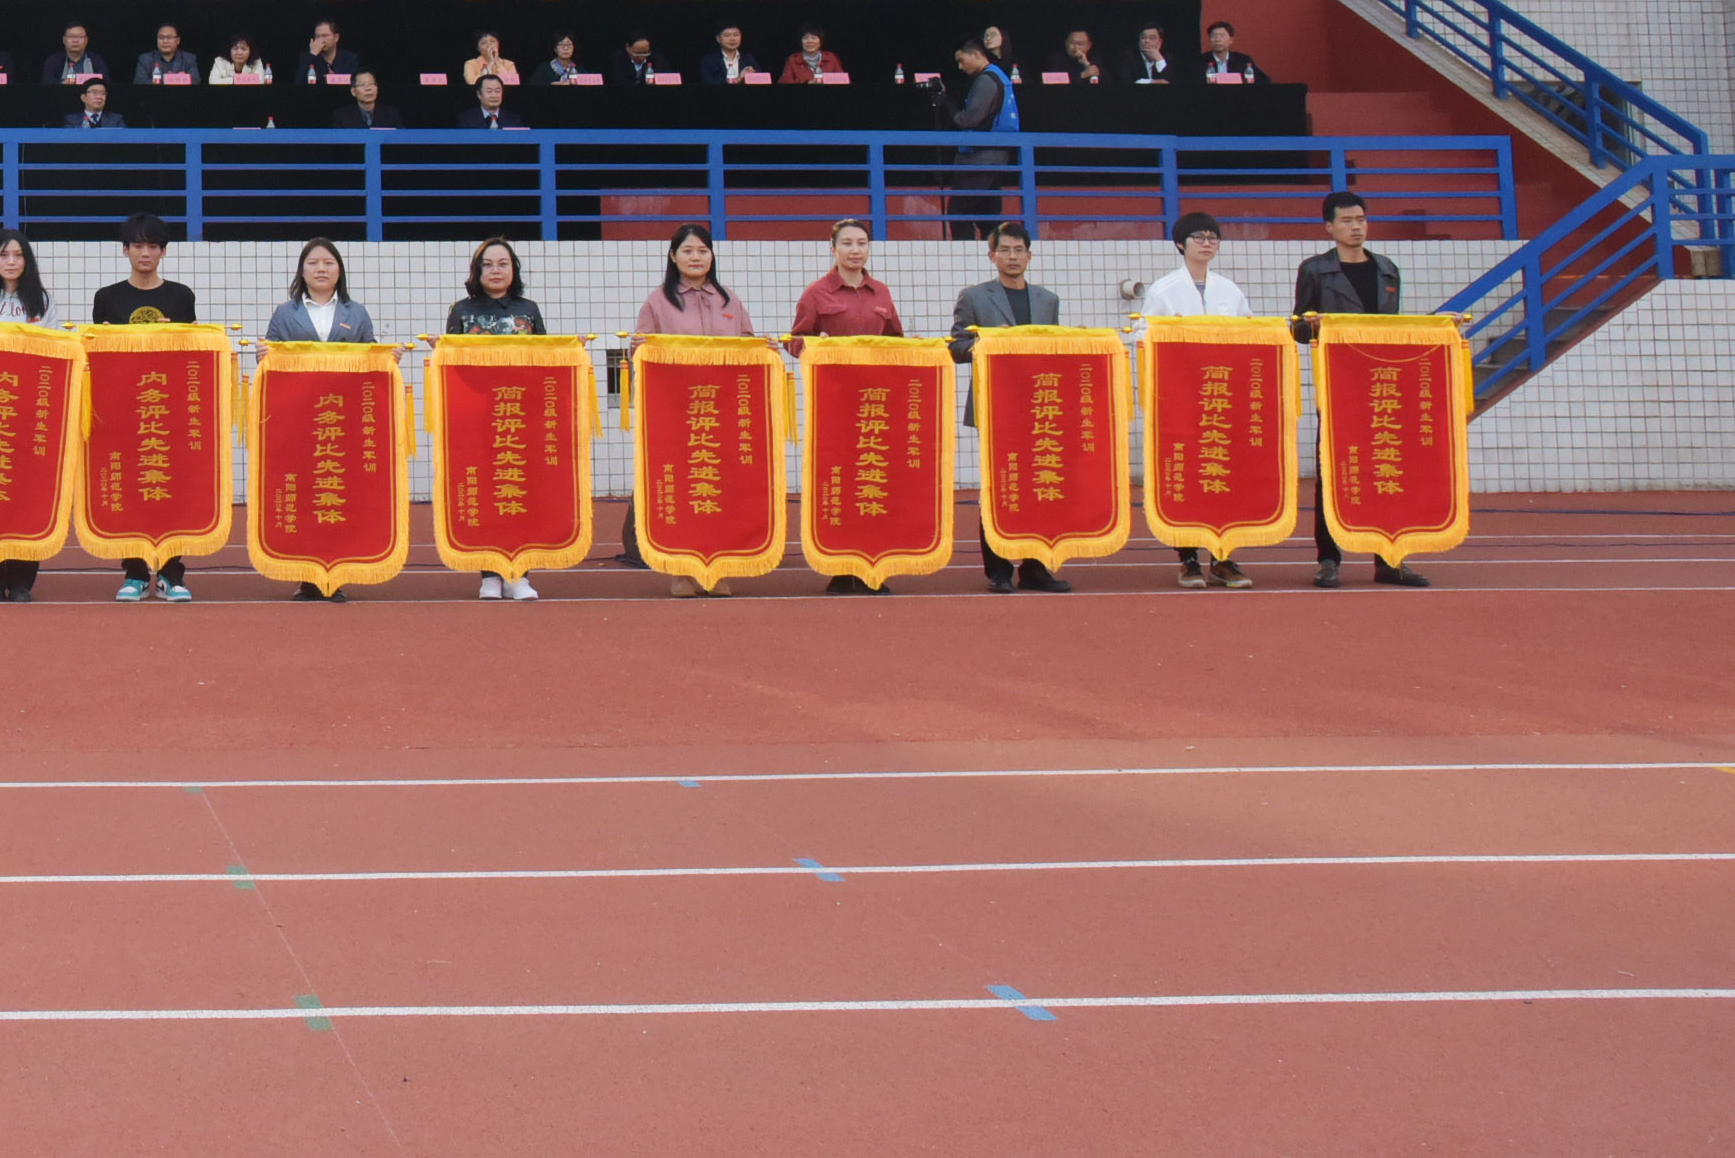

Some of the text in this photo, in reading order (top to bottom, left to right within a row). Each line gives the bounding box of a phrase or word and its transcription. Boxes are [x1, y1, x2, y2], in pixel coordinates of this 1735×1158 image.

[137, 372, 171, 501] 内务评比先进集体
[313, 394, 346, 524] 内务评比先进集体
[492, 386, 527, 515] 简报评比先进集体
[687, 385, 722, 514] 简报评比先进集体
[856, 388, 890, 516] 简报评比先进集体
[1031, 373, 1064, 501] 简报评比先进集体
[1199, 366, 1233, 493] 简报评比先进集体
[1370, 367, 1404, 494] 简报评比先进集体
